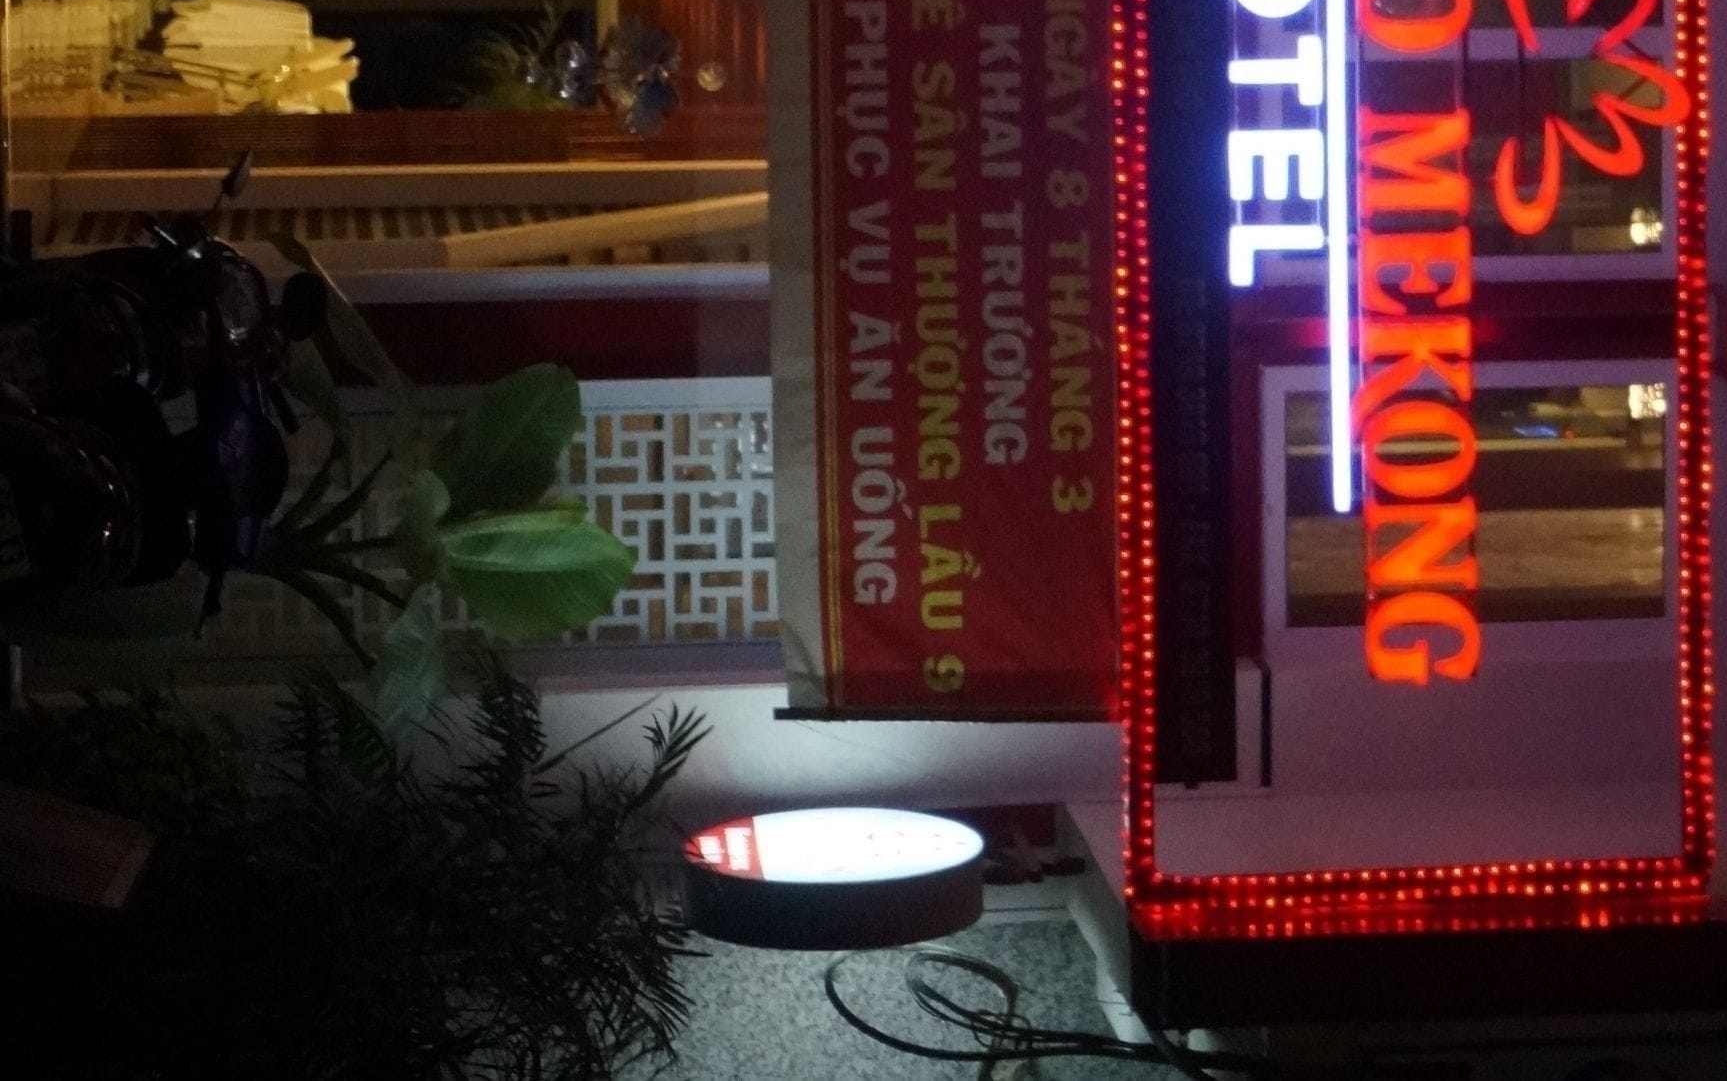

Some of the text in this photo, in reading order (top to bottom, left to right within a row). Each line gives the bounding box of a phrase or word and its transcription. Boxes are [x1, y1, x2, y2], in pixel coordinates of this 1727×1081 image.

[835, 0, 892, 179] PHỤC
[911, 59, 968, 192] SÂN
[838, 199, 893, 285] VỤ
[978, 23, 1033, 466] KHAI TRƯƠNG
[1047, 169, 1090, 209] 8
[848, 311, 902, 402] ĂN
[907, 212, 968, 481] THƯỢNG
[1048, 231, 1106, 452] THÁNG
[1350, 105, 1480, 686] MEKONG
[850, 426, 913, 606] UỐNG
[1051, 476, 1094, 514] 3
[921, 654, 965, 695] 9
